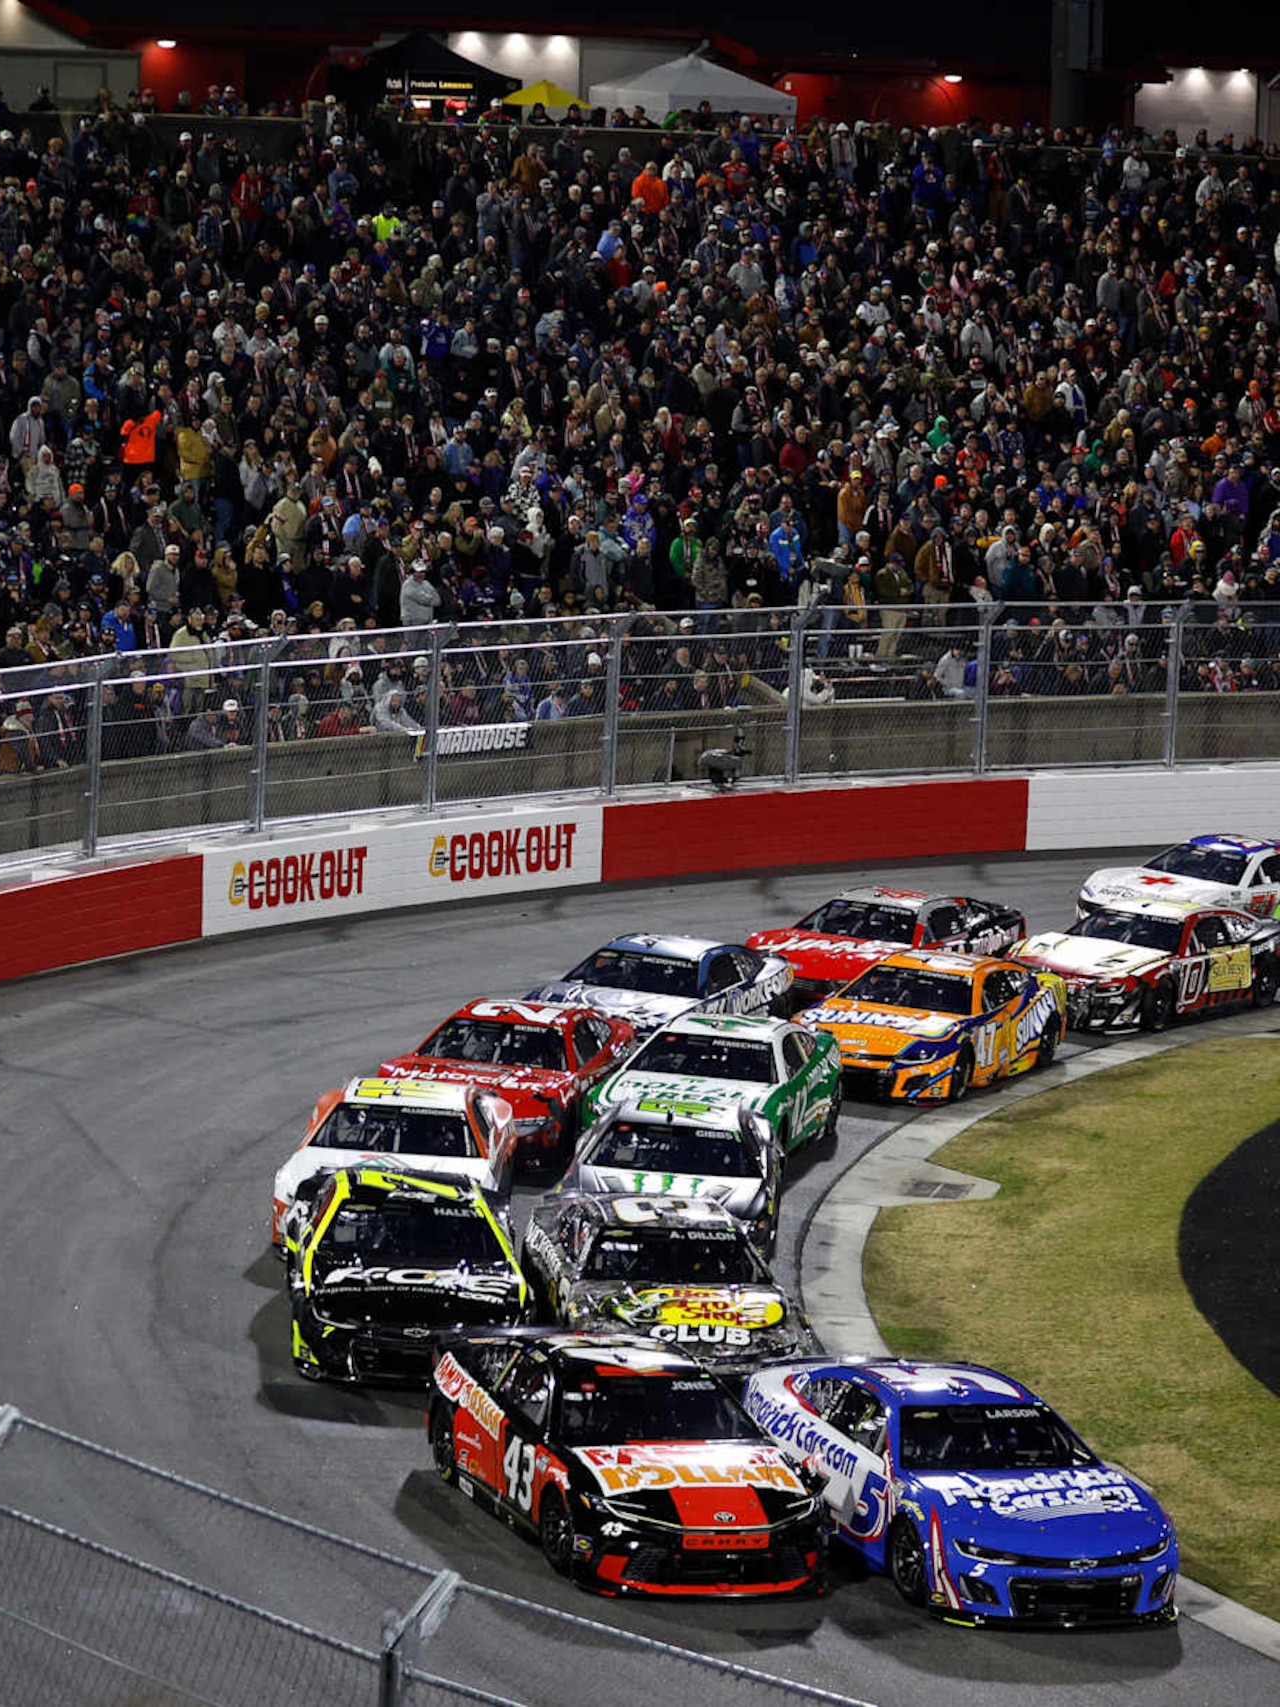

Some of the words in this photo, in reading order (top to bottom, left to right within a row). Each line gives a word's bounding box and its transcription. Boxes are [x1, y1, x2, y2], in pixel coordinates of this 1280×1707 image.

[436, 728, 527, 755] MADHOUSE
[450, 829, 521, 881] COOK
[525, 823, 577, 873] OUT
[248, 853, 315, 909] COOK
[319, 846, 368, 899] OUT
[1179, 960, 1206, 1004] 10
[695, 1128, 734, 1141] GIBBS
[433, 1206, 479, 1219] HALEY
[670, 1231, 685, 1241] A.
[687, 1231, 737, 1242] DILLON
[650, 1323, 751, 1347] CLUB
[671, 1380, 716, 1391] JONES
[985, 1408, 1040, 1420] LARSON
[503, 1435, 535, 1511] 43
[599, 1465, 800, 1490] DOLLAR
[848, 1471, 889, 1535] 5
[600, 1521, 625, 1537] 43
[686, 1537, 767, 1546] CAMRY
[968, 1562, 989, 1578] 5
